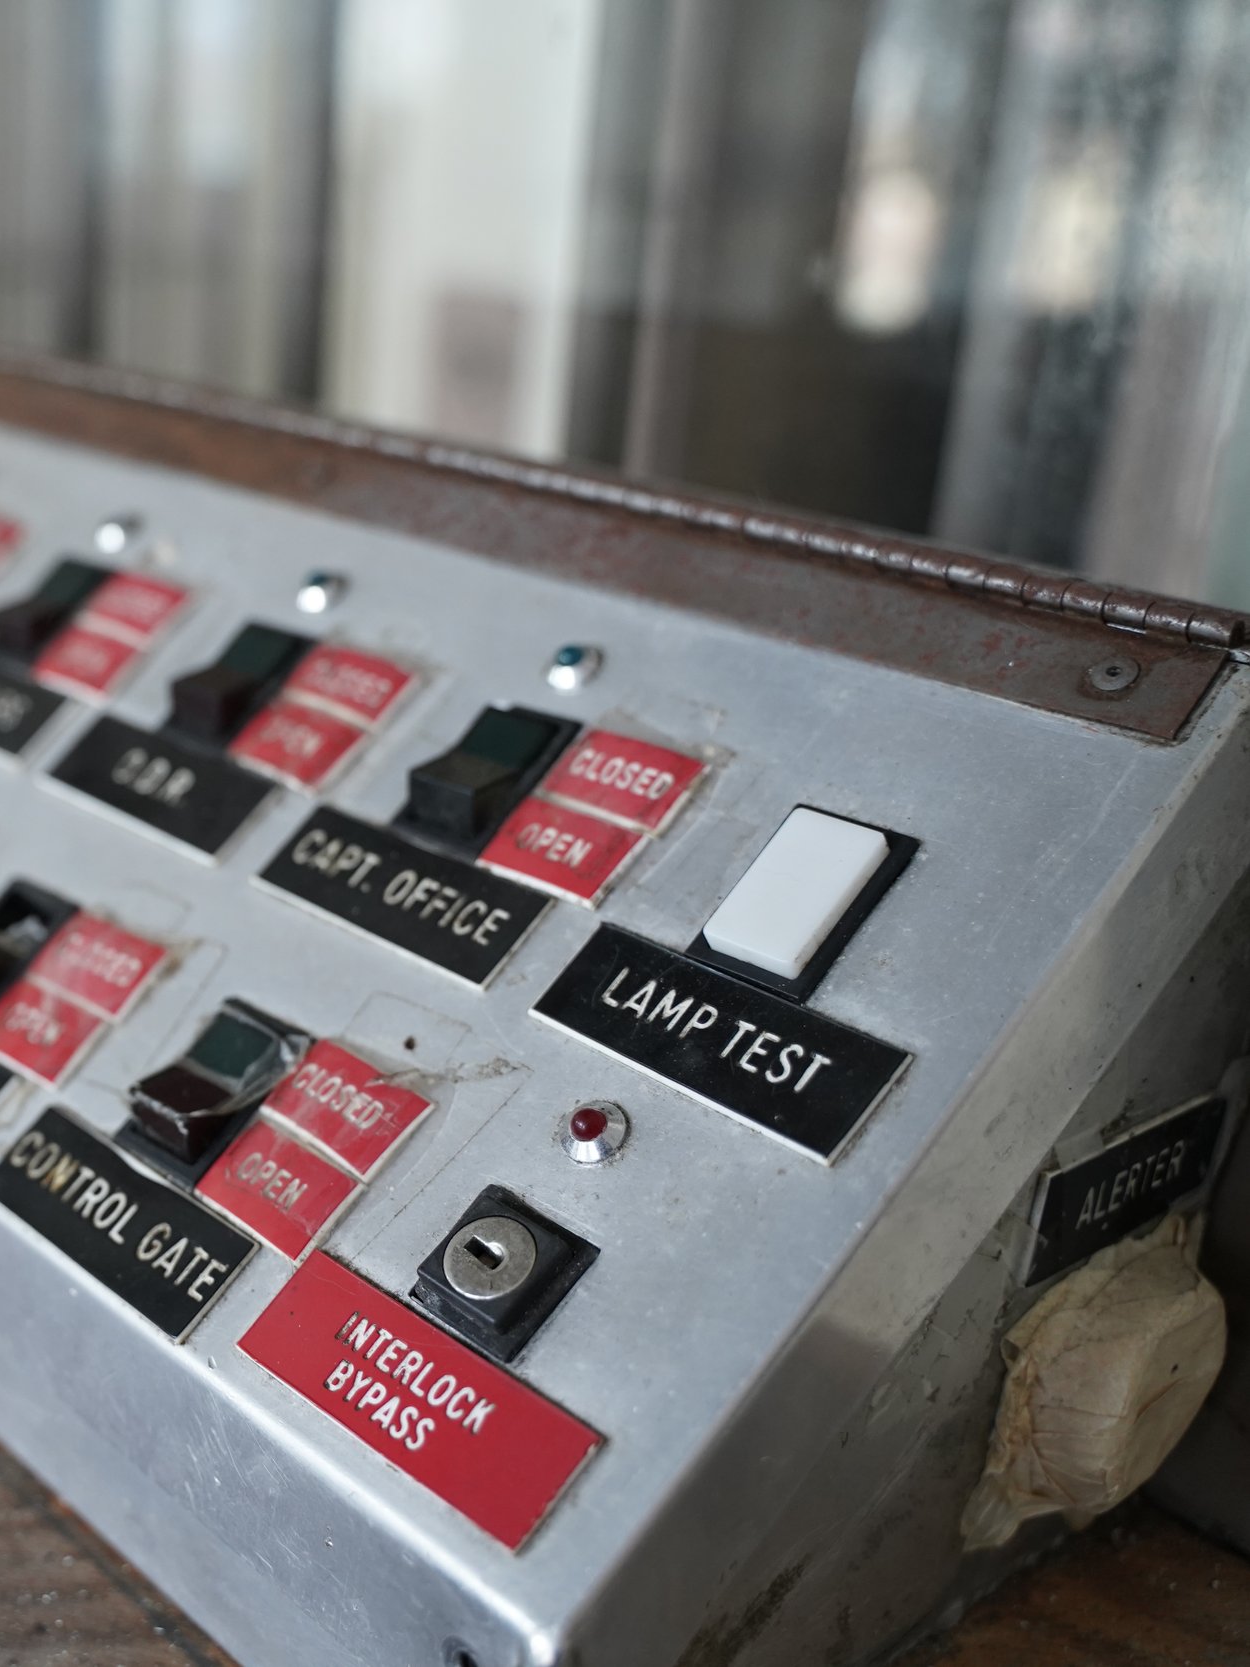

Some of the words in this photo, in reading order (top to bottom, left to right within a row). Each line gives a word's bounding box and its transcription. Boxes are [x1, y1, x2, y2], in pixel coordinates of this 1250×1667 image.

[569, 746, 675, 801] CLOSED
[291, 828, 381, 893] CAPT.
[382, 869, 511, 946] OFFICE
[517, 823, 594, 868] OPEN
[4, 1001, 65, 1046] OPEN
[601, 967, 719, 1039] LAMP
[720, 1020, 832, 1093] TEST
[293, 1062, 385, 1130] CLOSED
[10, 1130, 139, 1245] CONTROL
[137, 1222, 228, 1301] GATE
[237, 1151, 308, 1210] OPEN
[1075, 1140, 1186, 1230] ALERTER
[323, 1358, 437, 1451] BYPASS
[335, 1311, 496, 1435] INTERLOCK
